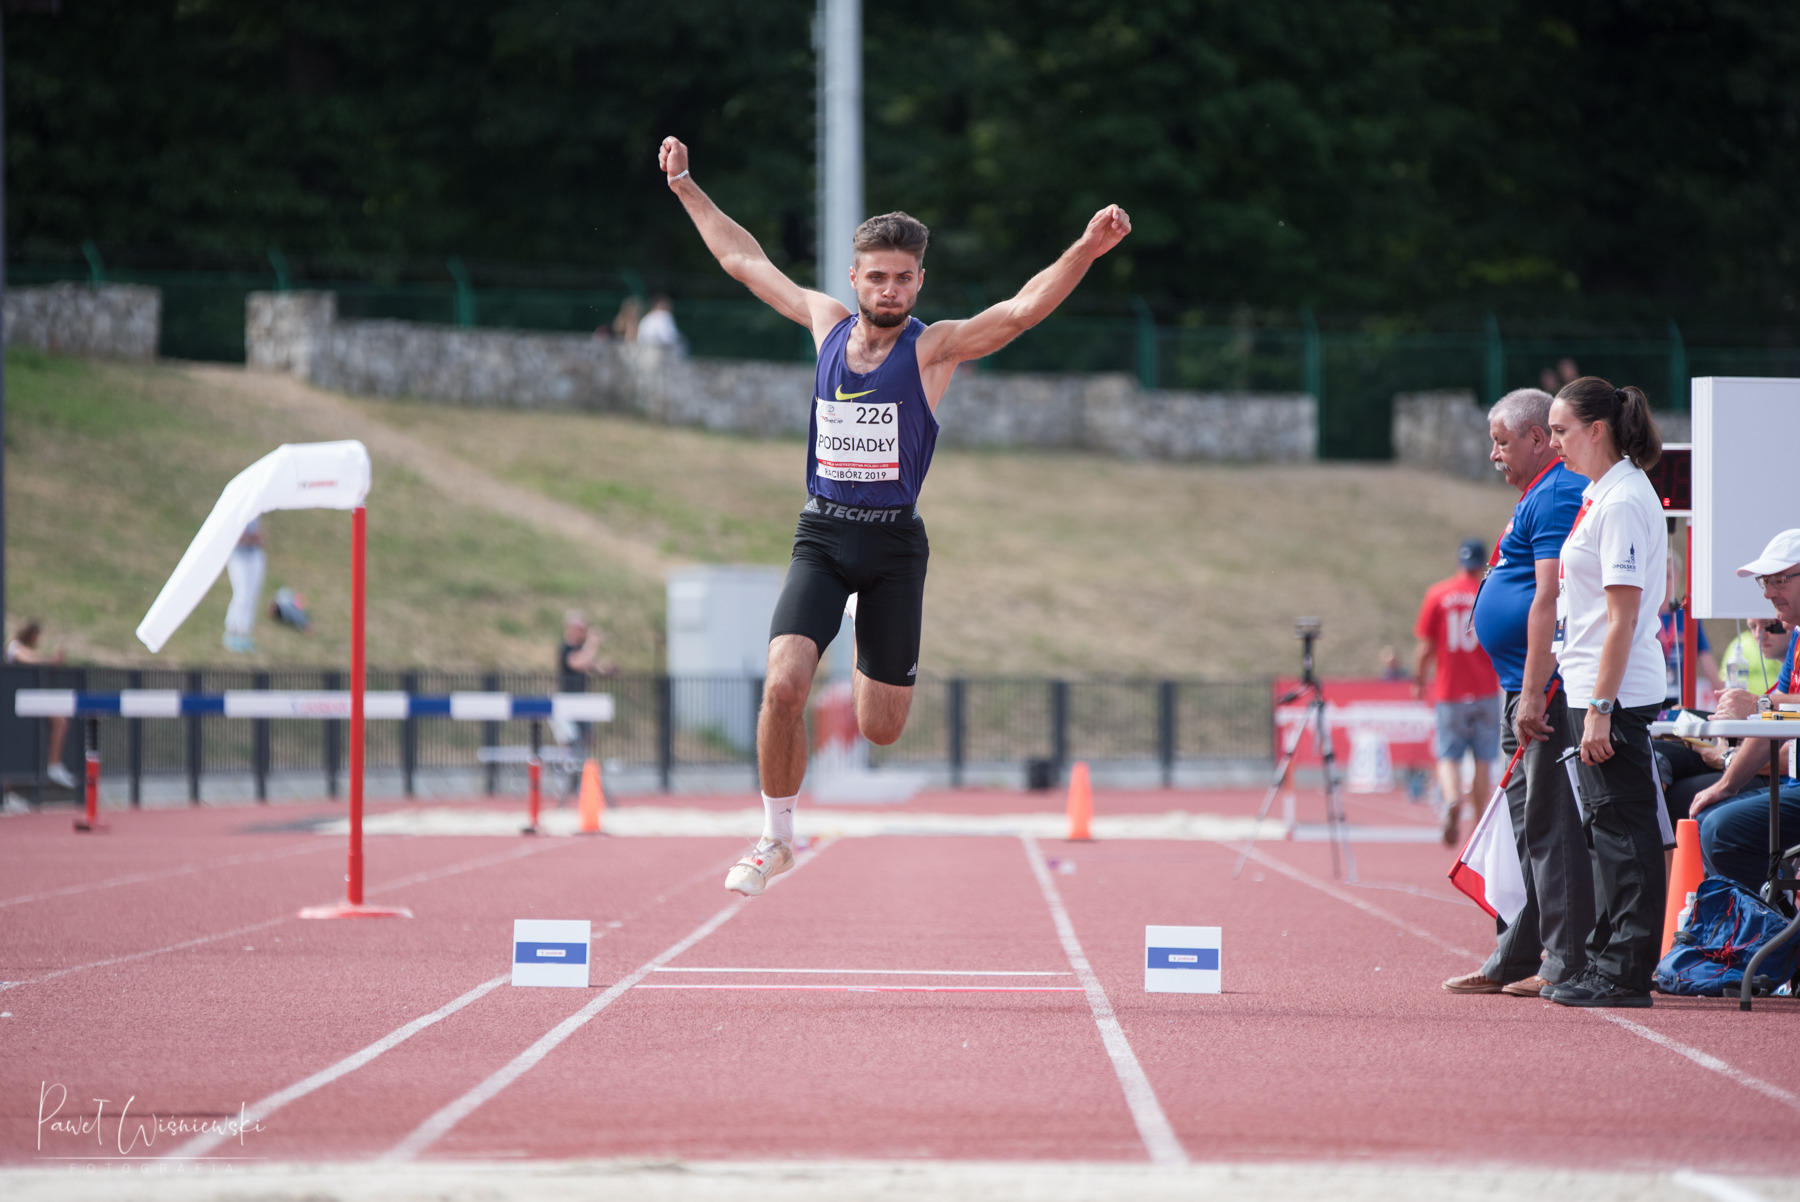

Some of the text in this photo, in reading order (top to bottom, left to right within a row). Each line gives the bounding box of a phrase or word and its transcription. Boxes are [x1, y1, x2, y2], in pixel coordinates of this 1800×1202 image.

[856, 407, 893, 424] 226
[818, 434, 895, 452] PODSIADŁY
[825, 468, 887, 480] RACIBÓRZ 2019
[824, 502, 901, 522] TECHFIT
